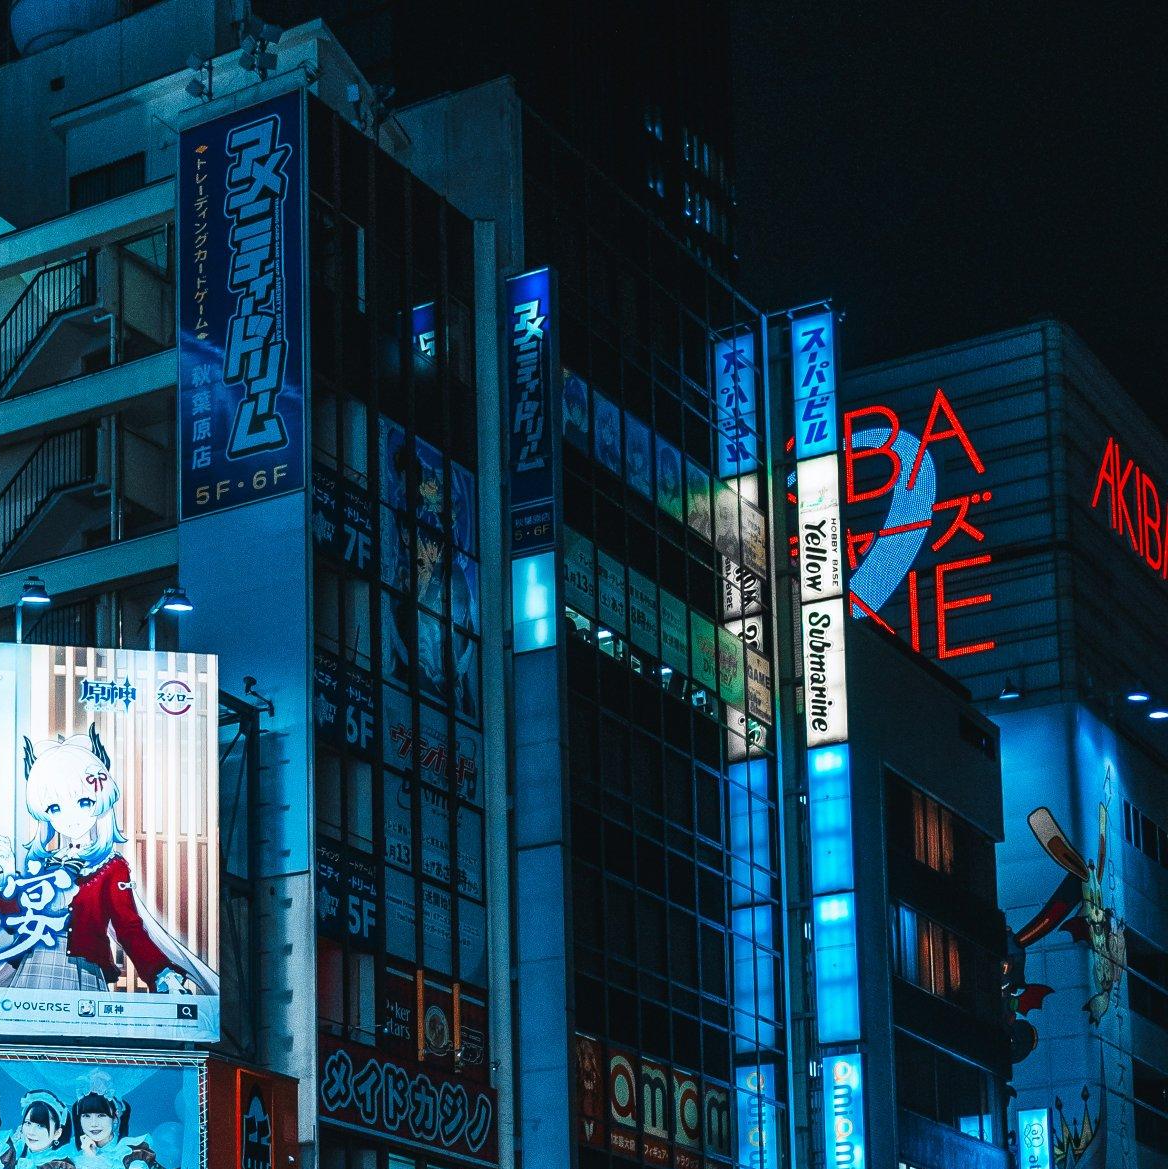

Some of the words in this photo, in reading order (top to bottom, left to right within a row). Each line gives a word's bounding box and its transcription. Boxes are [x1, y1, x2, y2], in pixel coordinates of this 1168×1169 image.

[801, 325, 831, 446] スーパービル
[344, 524, 372, 569] 7F
[803, 518, 825, 593] Yellow
[831, 518, 839, 553] HOBBY
[832, 559, 840, 588] BASE
[806, 610, 831, 733] Submarine
[80, 674, 137, 714] 原神
[156, 691, 195, 702] スシロー
[345, 704, 375, 749] 6F
[347, 894, 377, 938] 5F
[103, 1004, 125, 1015] 原神
[321, 1049, 492, 1153] メイドカジノ
